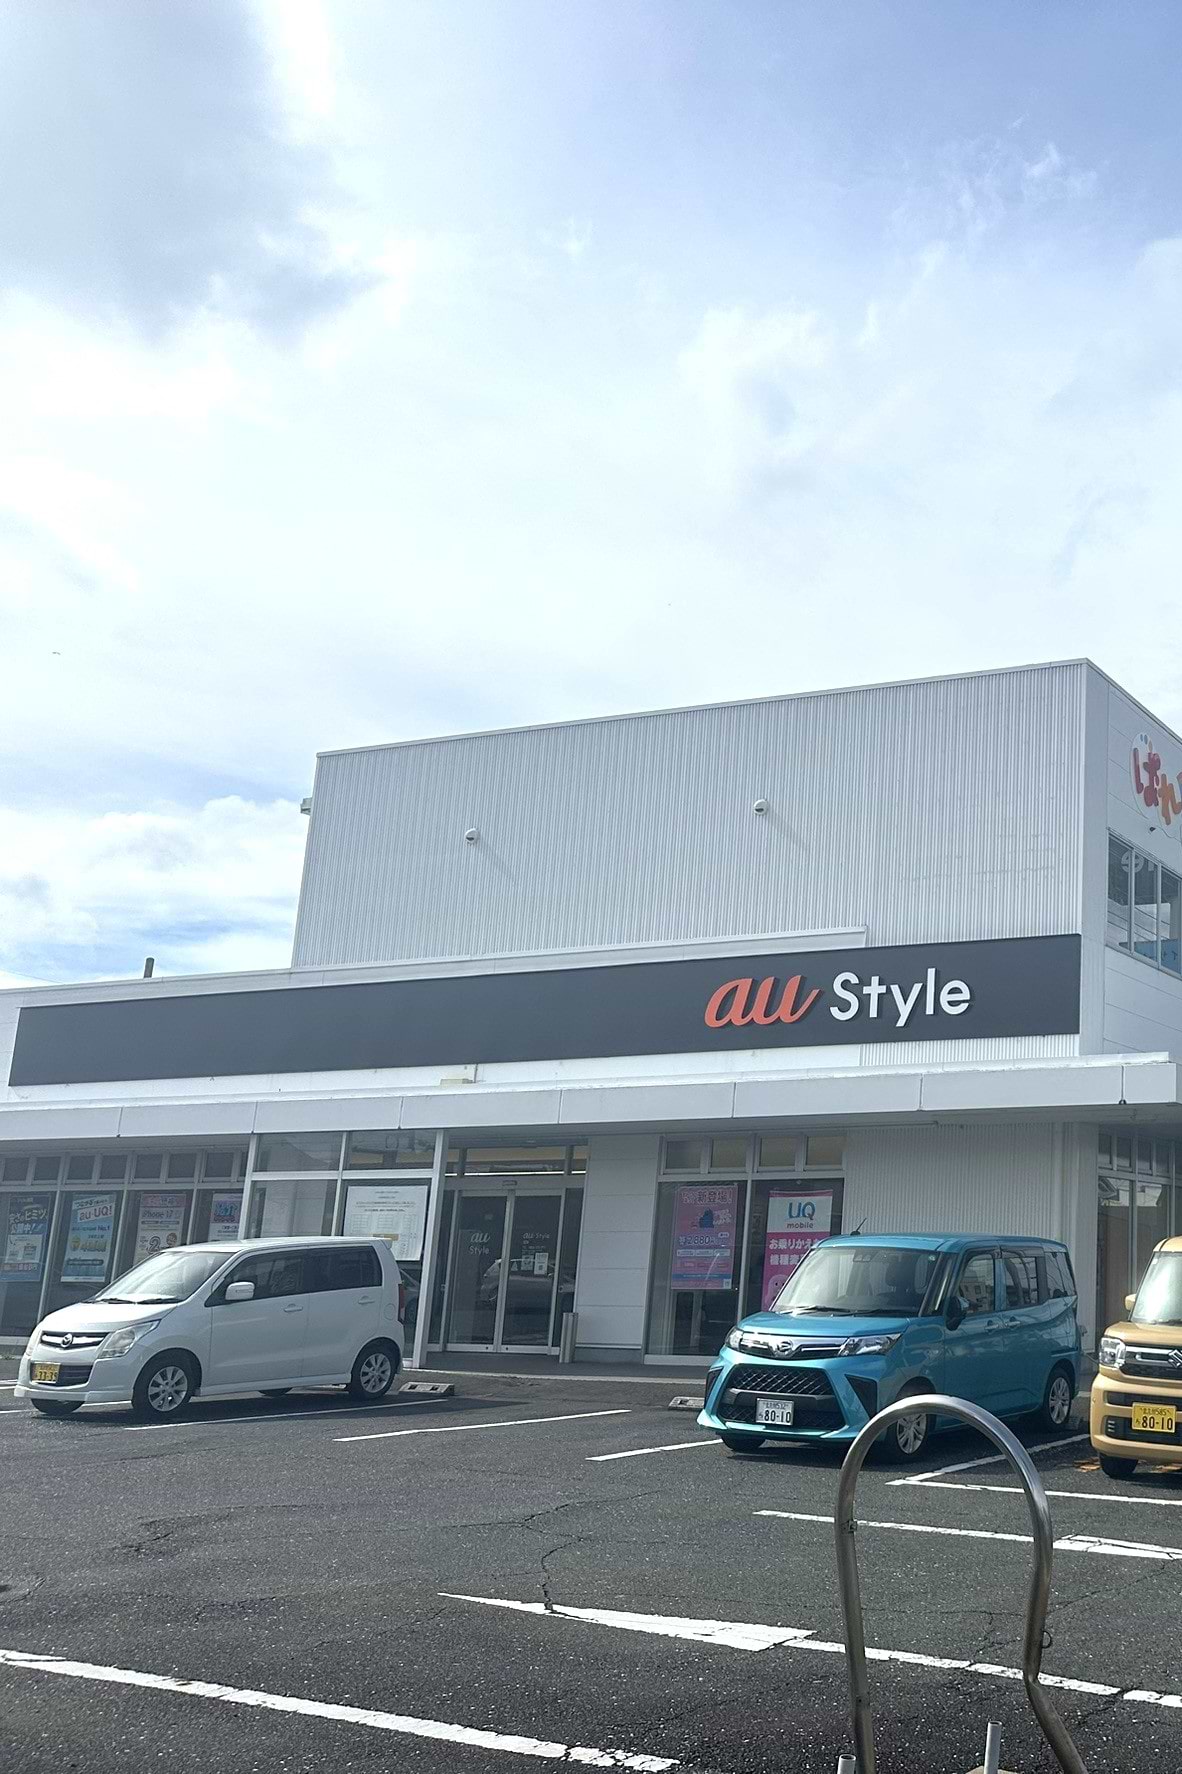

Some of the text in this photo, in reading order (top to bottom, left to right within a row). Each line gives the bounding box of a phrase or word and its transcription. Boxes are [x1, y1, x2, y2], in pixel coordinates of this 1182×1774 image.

[704, 967, 971, 1028] au Style
[788, 1201, 816, 1220] UQ
[787, 1221, 814, 1229] mobile
[470, 1232, 490, 1242] au
[769, 1238, 818, 1249] お乗りかえ
[469, 1245, 490, 1255] Style
[770, 1254, 804, 1265] 機種変
[764, 1409, 791, 1423] 80-10
[1141, 1415, 1173, 1430] 80-10
